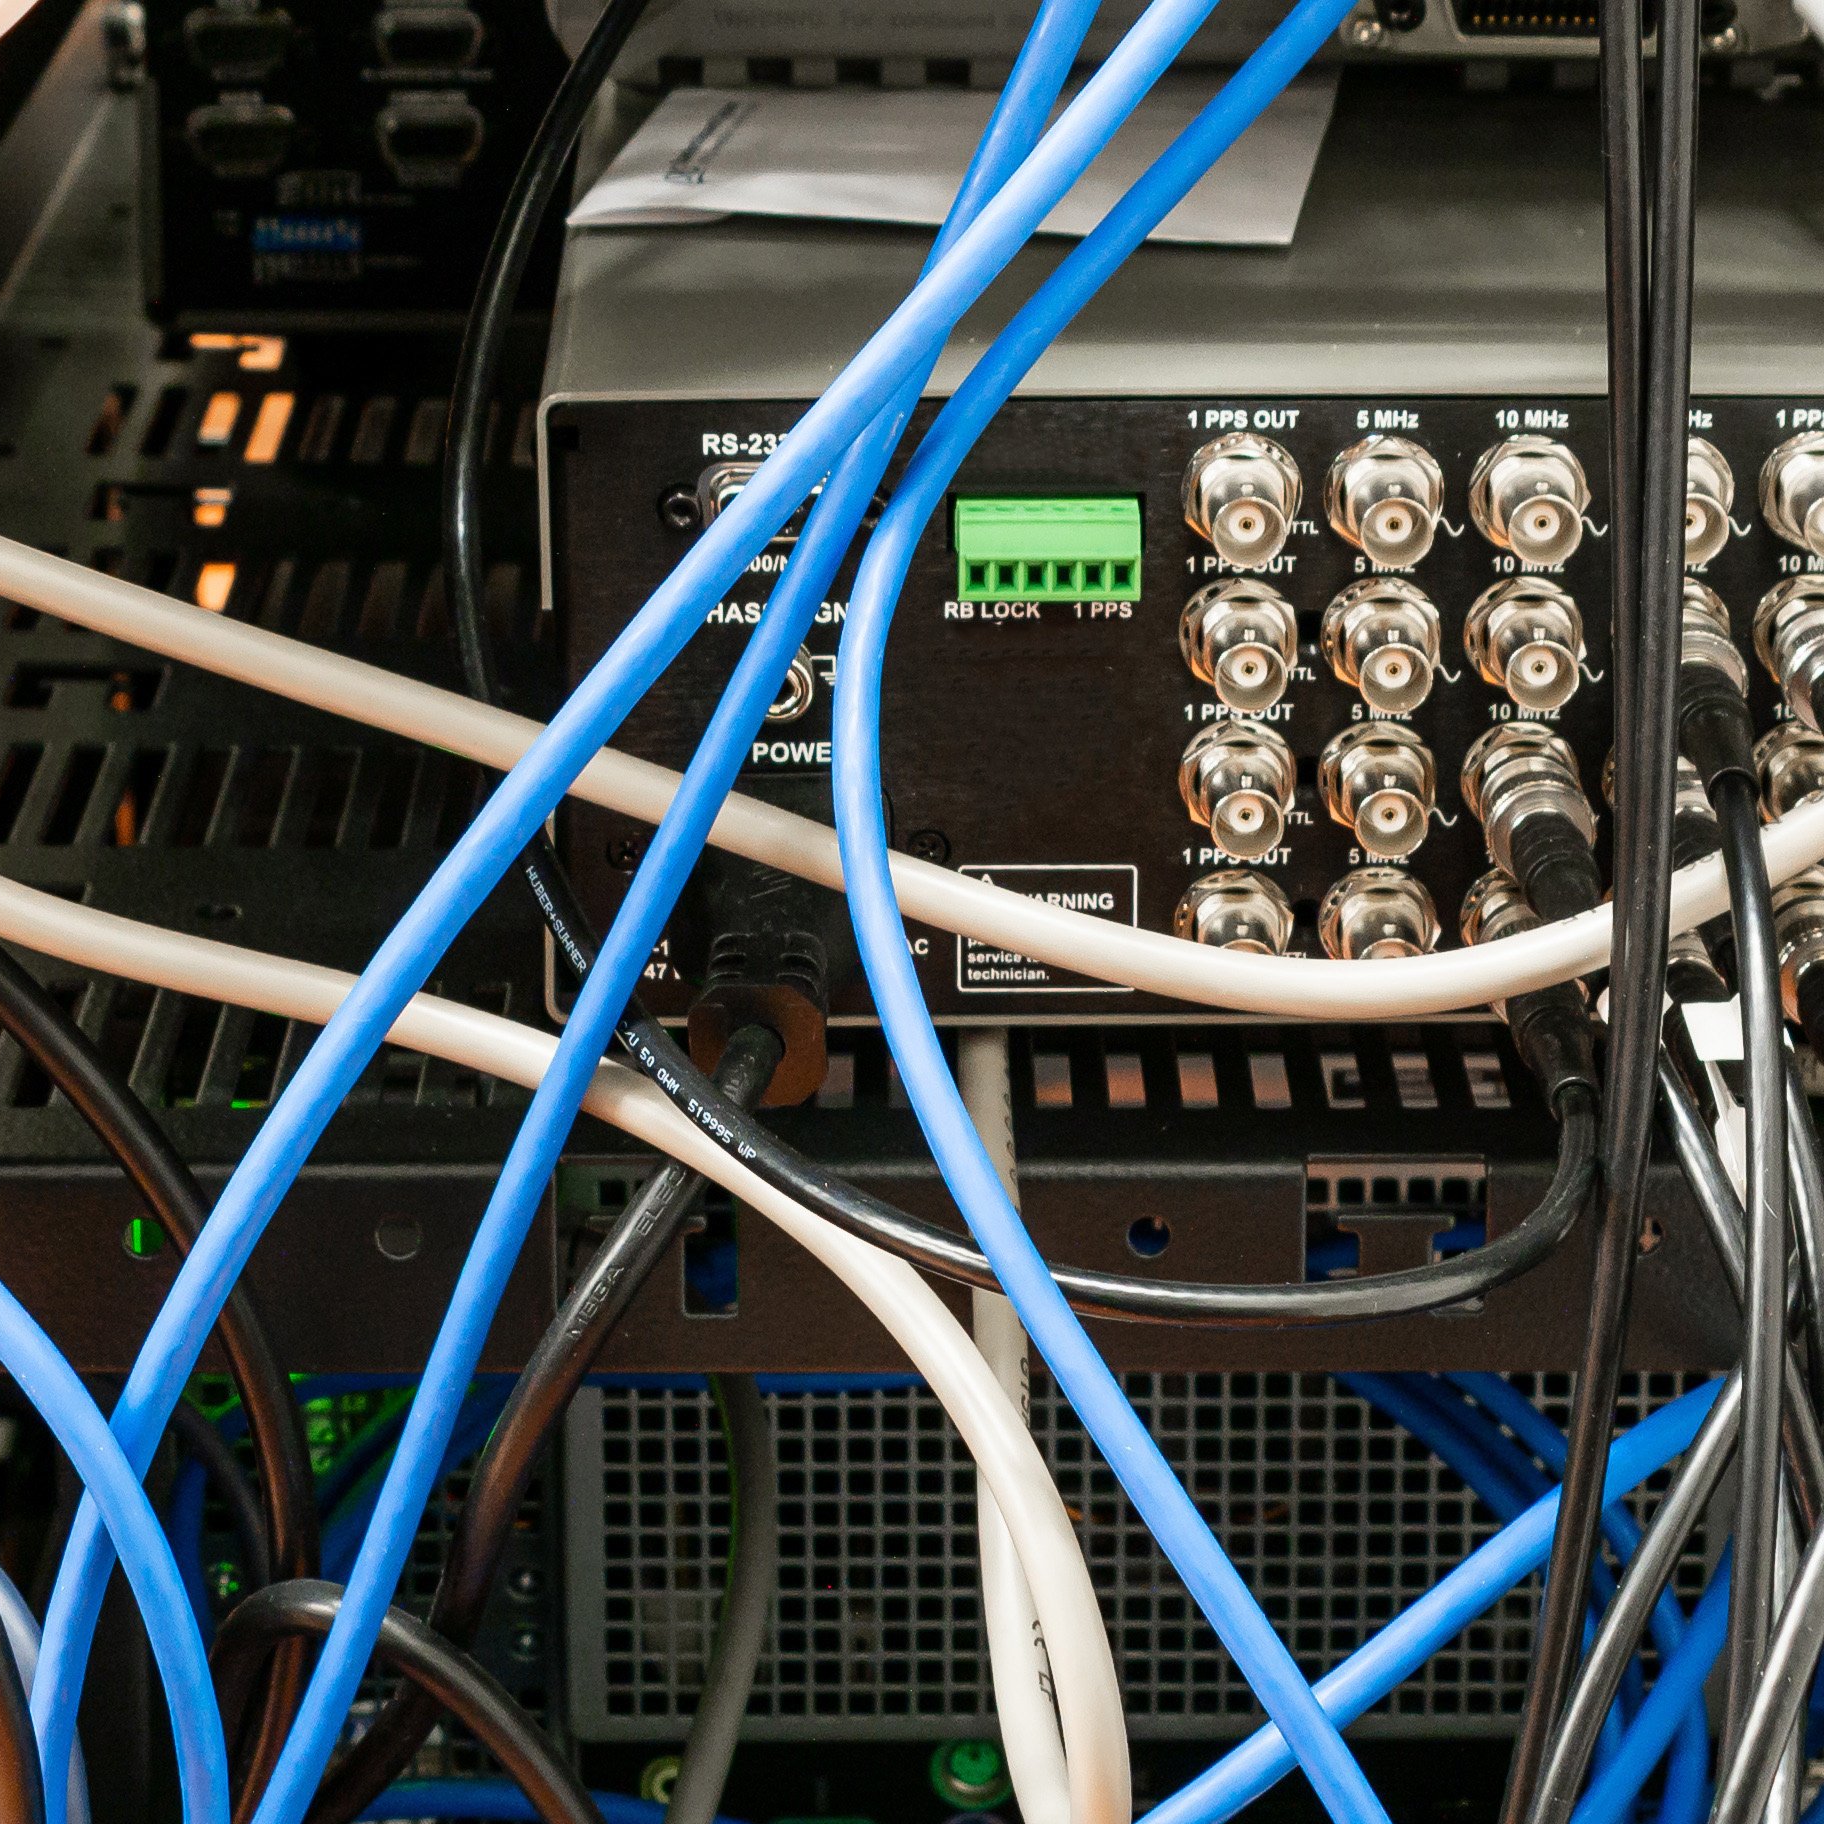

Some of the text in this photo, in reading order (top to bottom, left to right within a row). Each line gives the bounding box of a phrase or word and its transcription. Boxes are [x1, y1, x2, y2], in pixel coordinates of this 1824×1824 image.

[1188, 410, 1299, 428] 1 PPS OUT
[1357, 410, 1419, 429] 5 MHz
[1496, 410, 1568, 428] 10 MHz
[1688, 409, 1713, 427] Hz
[1776, 409, 1785, 427] 1
[1186, 556, 1195, 573] 1
[1355, 556, 1365, 573] 5
[1492, 555, 1515, 573] 10
[1779, 556, 1800, 573] 10
[944, 602, 1041, 618] RB LOCK
[1073, 602, 1133, 618] 1 PPS
[1184, 704, 1192, 720] 1
[1351, 704, 1361, 720] 5
[1489, 704, 1511, 720] 10
[752, 743, 832, 763] POWE
[1183, 848, 1192, 864] 1
[1349, 848, 1360, 864] 5
[526, 865, 587, 975] HUBER+SUHNER
[967, 967, 1050, 981] technician.
[640, 1046, 655, 1068] 50
[656, 1068, 680, 1095] OHM
[688, 1098, 734, 1143] 519995
[737, 1141, 758, 1160] WP
